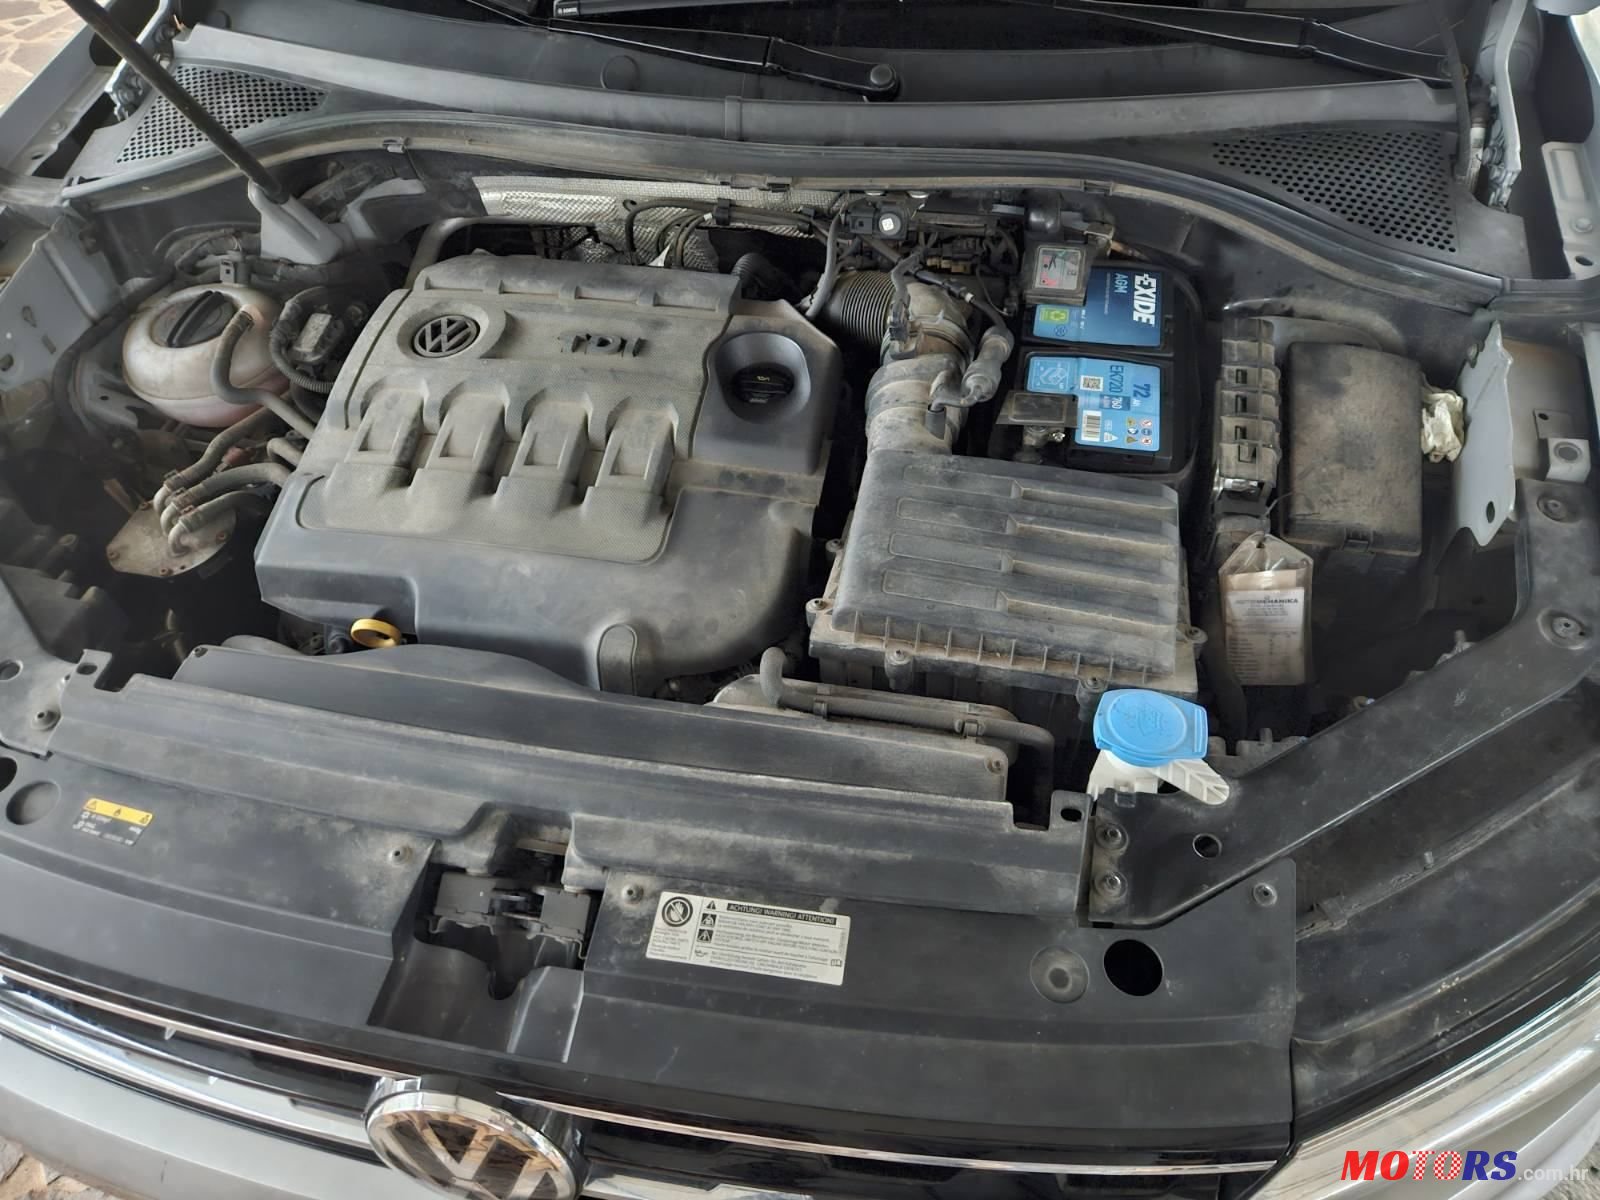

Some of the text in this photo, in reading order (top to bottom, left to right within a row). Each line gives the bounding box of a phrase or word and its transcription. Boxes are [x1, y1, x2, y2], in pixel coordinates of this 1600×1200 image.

[1115, 273, 1128, 294] AGM
[1133, 273, 1157, 326] EXIDE
[558, 333, 642, 357] TDI
[1109, 365, 1124, 393] EK720
[1133, 383, 1151, 399] 72
[728, 904, 761, 915] ACHTUNG!
[763, 909, 796, 919] WARNING!
[797, 913, 836, 925] ATTENTION!
